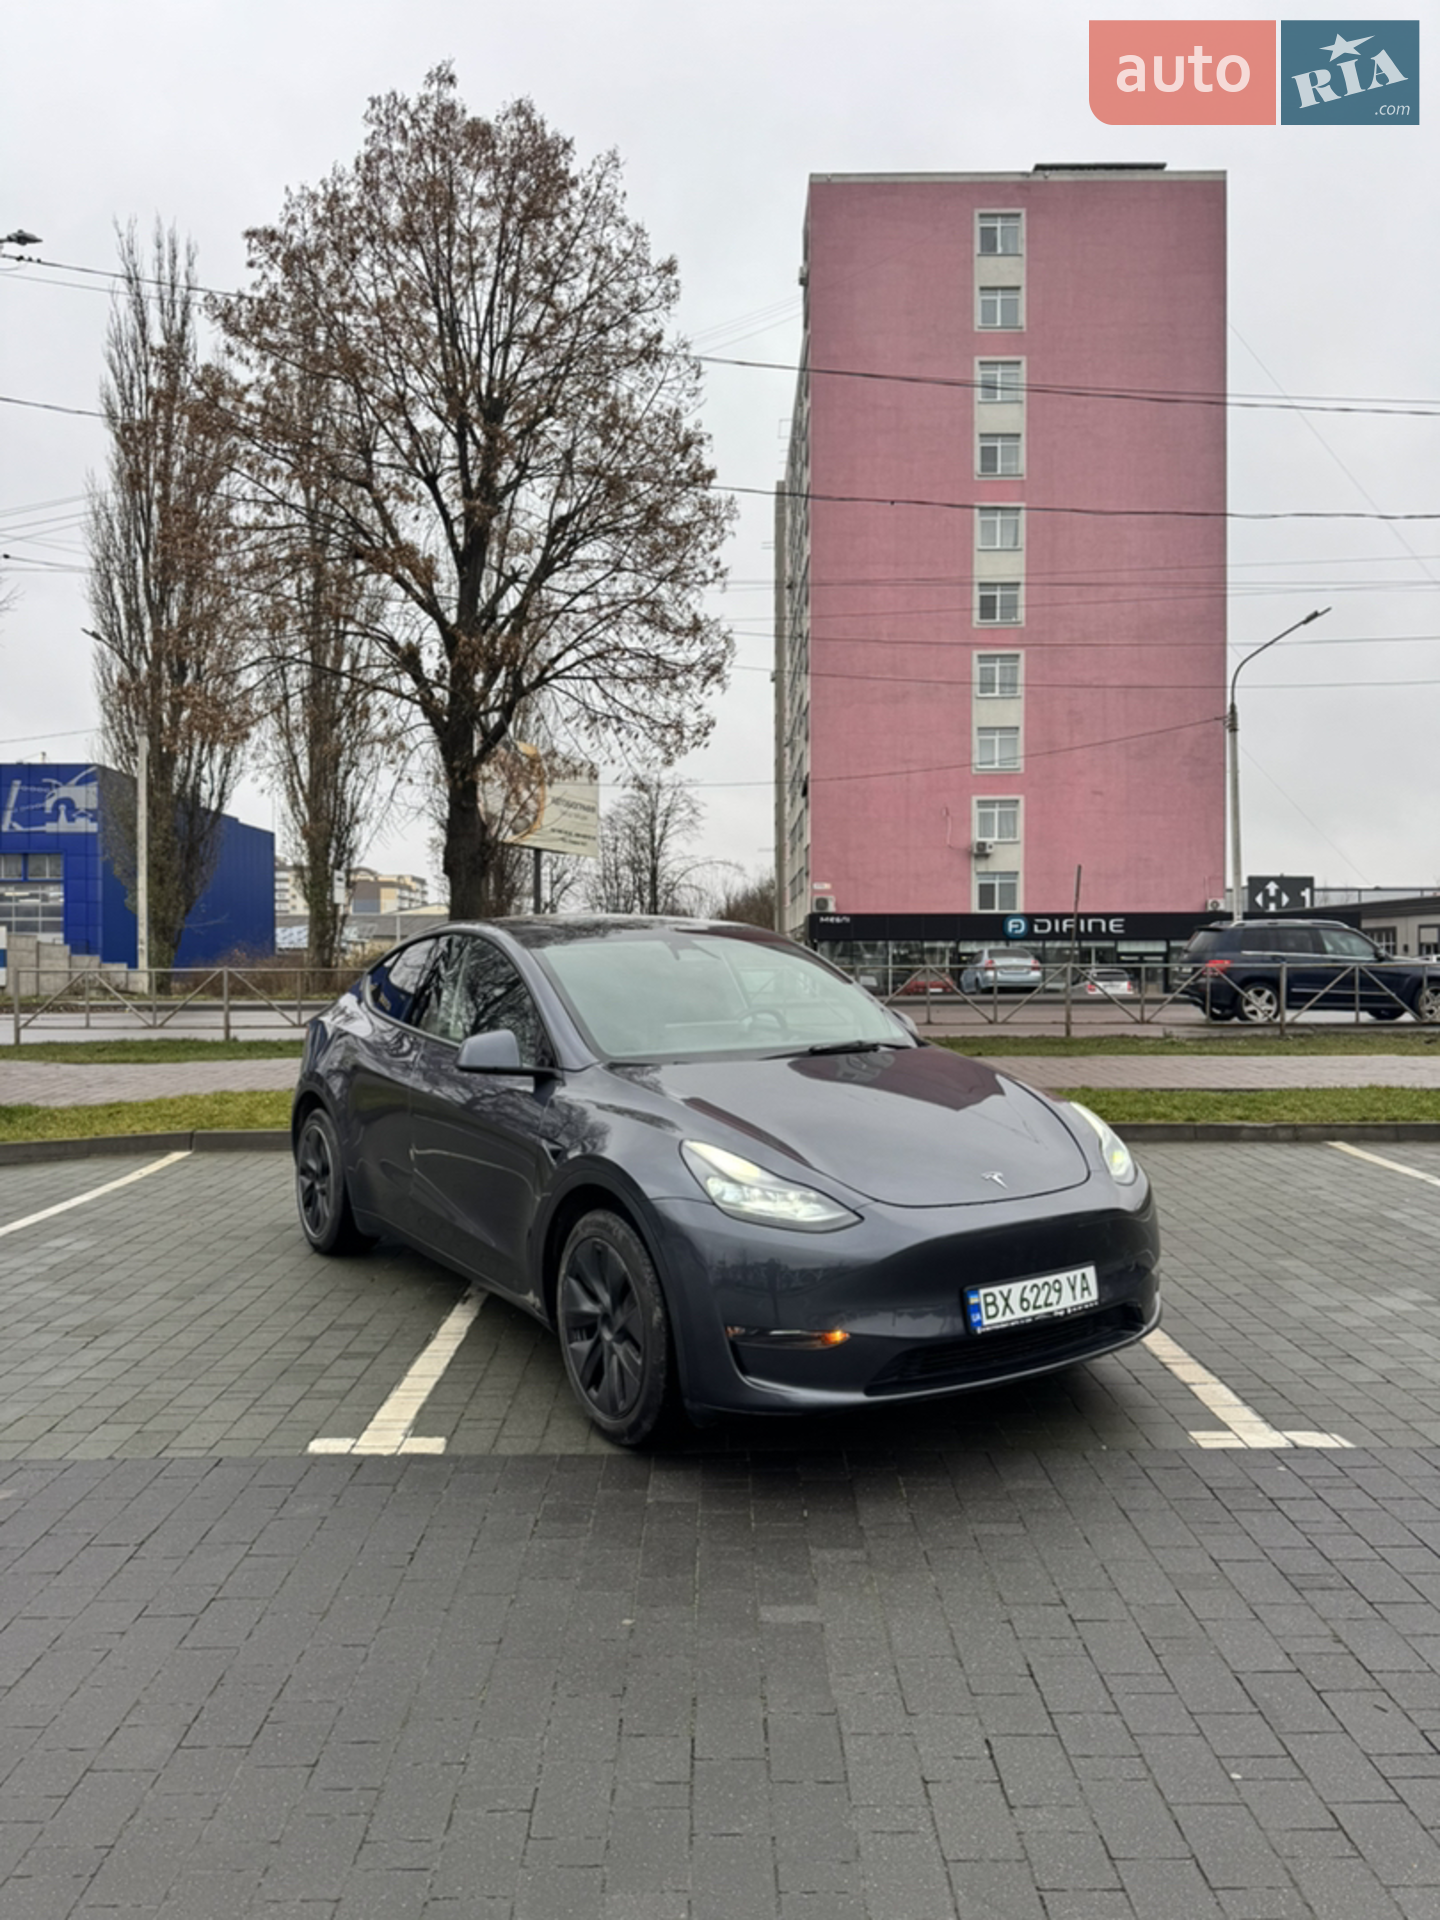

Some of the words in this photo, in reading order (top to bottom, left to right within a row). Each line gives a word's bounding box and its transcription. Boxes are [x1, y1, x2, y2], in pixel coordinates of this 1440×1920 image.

[1033, 918, 1125, 934] DIFINE
[983, 1288, 1015, 1320] BX
[1019, 1278, 1063, 1313] 6229
[1067, 1272, 1092, 1301] YA
